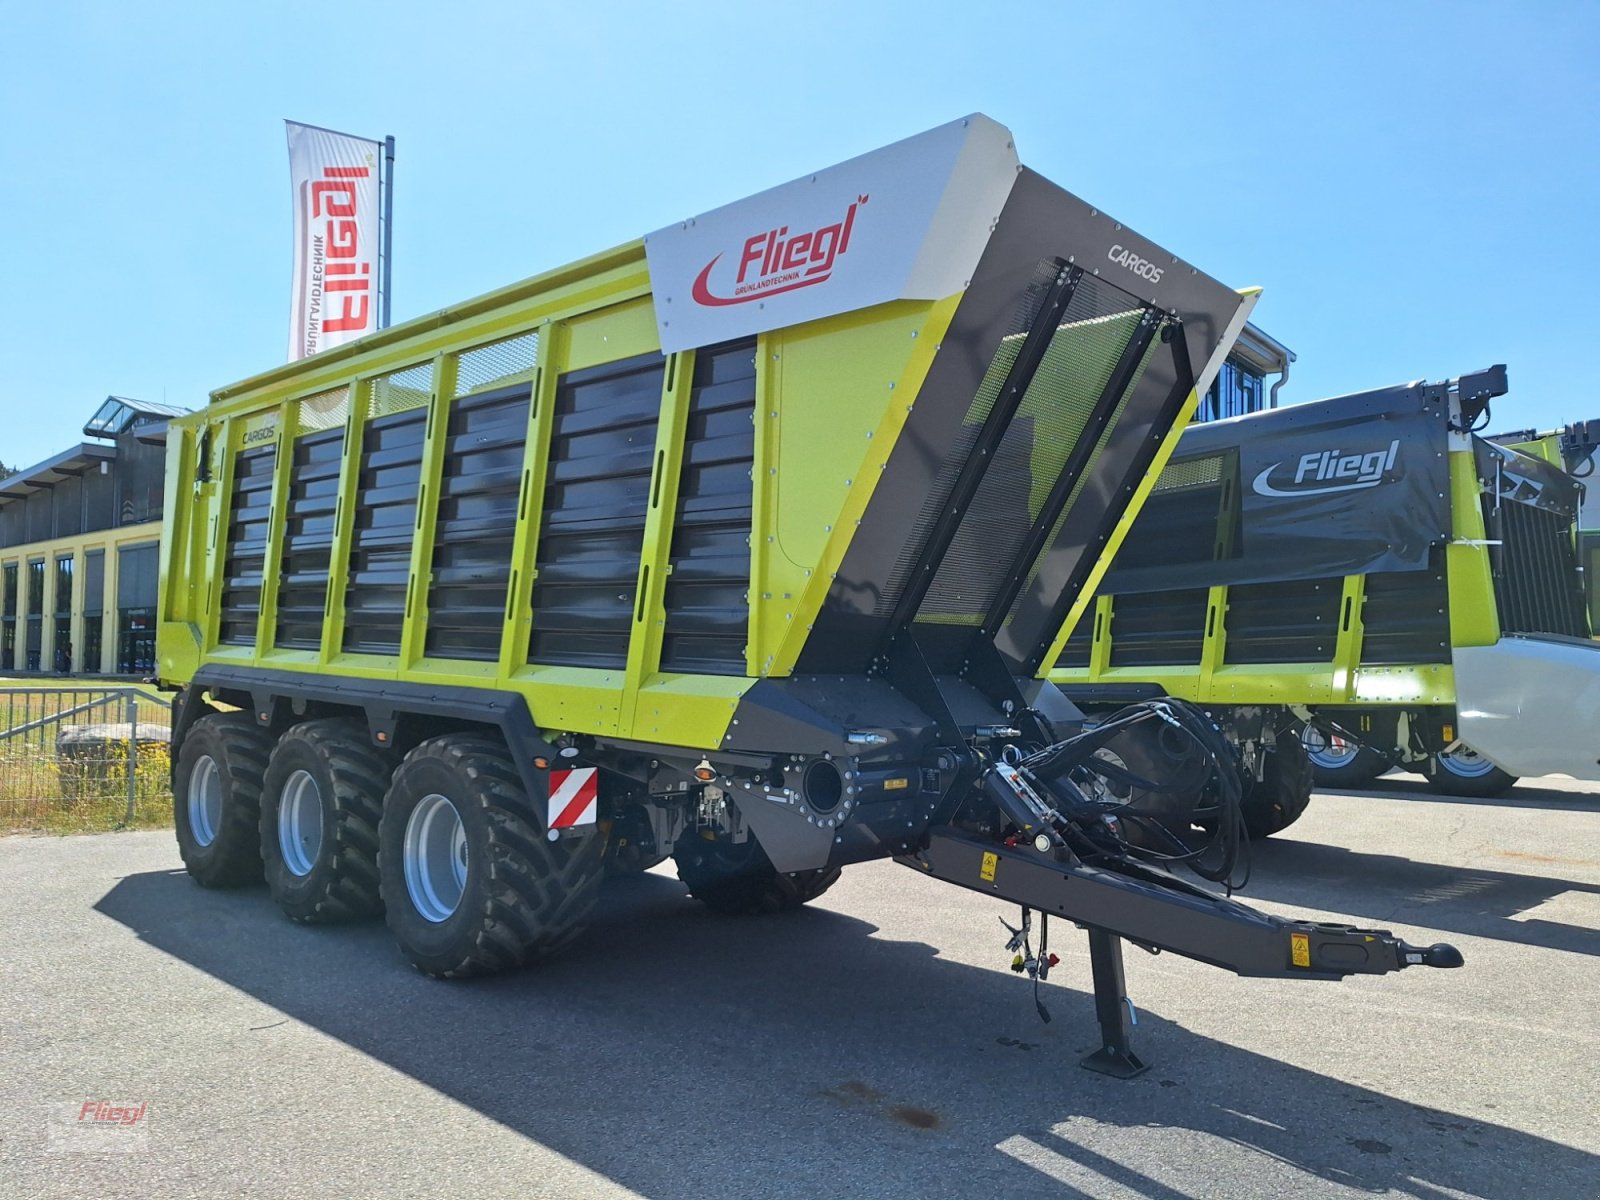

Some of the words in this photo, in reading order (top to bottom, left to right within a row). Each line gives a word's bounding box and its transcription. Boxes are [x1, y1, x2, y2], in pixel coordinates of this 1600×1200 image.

[736, 203, 858, 283] Fliegl
[734, 271, 800, 296] GRÜNLANDTECHNIK
[1107, 244, 1164, 284] CARGOS
[242, 425, 275, 444] CARGOS
[1294, 439, 1399, 483] Fliegl
